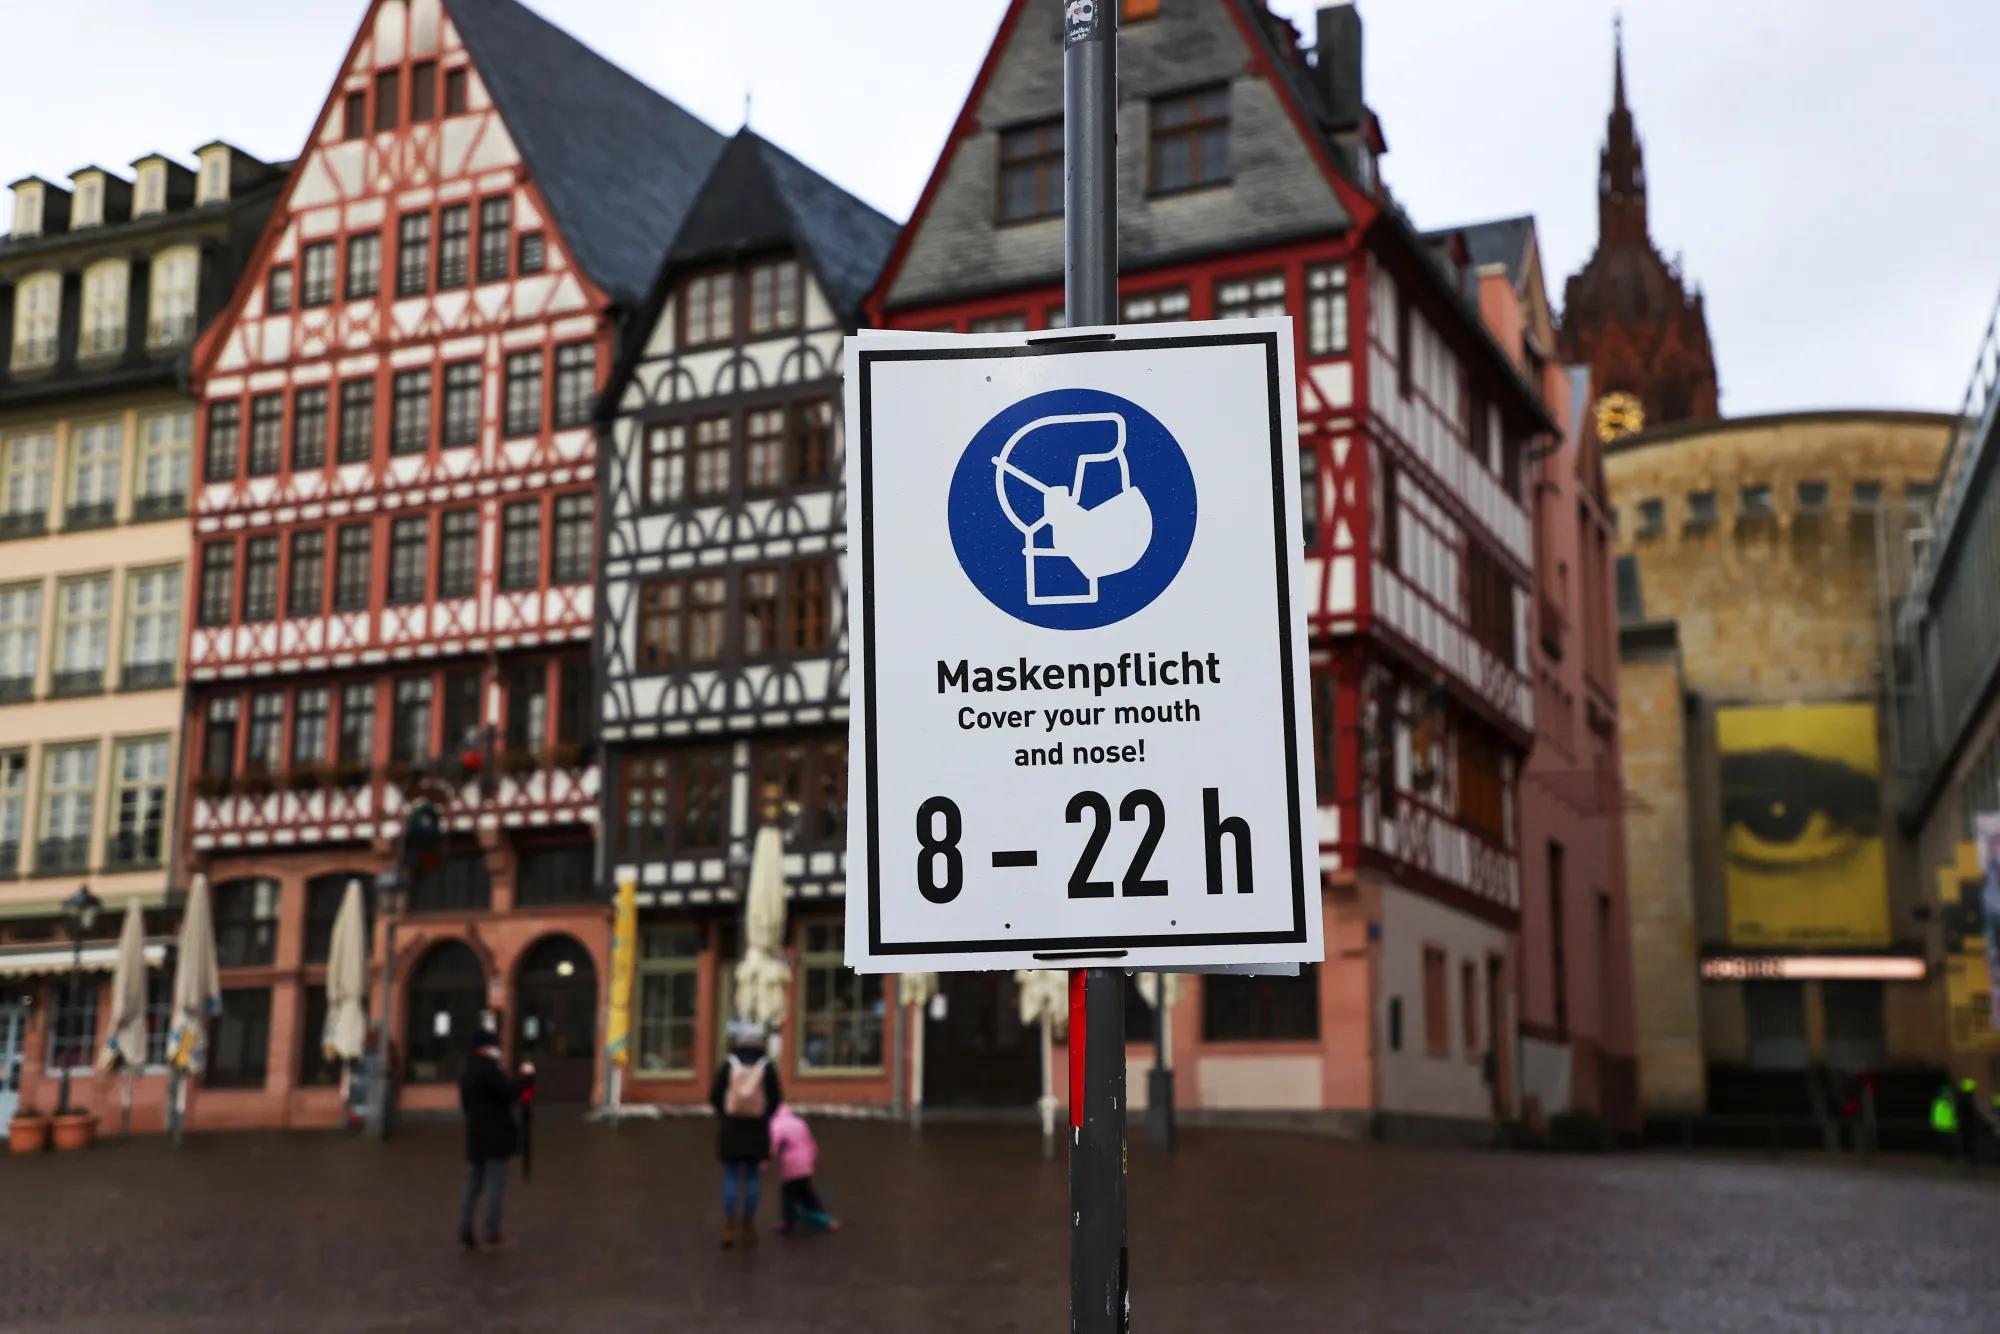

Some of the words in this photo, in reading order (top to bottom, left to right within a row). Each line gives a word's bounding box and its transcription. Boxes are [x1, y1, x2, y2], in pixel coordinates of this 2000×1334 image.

[937, 652, 1221, 697] Maskenpflicht
[958, 706, 1037, 730] Cover
[1043, 708, 1106, 733] your
[1114, 698, 1201, 725] mouth
[1014, 742, 1063, 767] and
[1073, 739, 1146, 765] nose!
[916, 795, 964, 905] 8
[1065, 788, 1169, 899] 22
[1202, 787, 1254, 895] h
